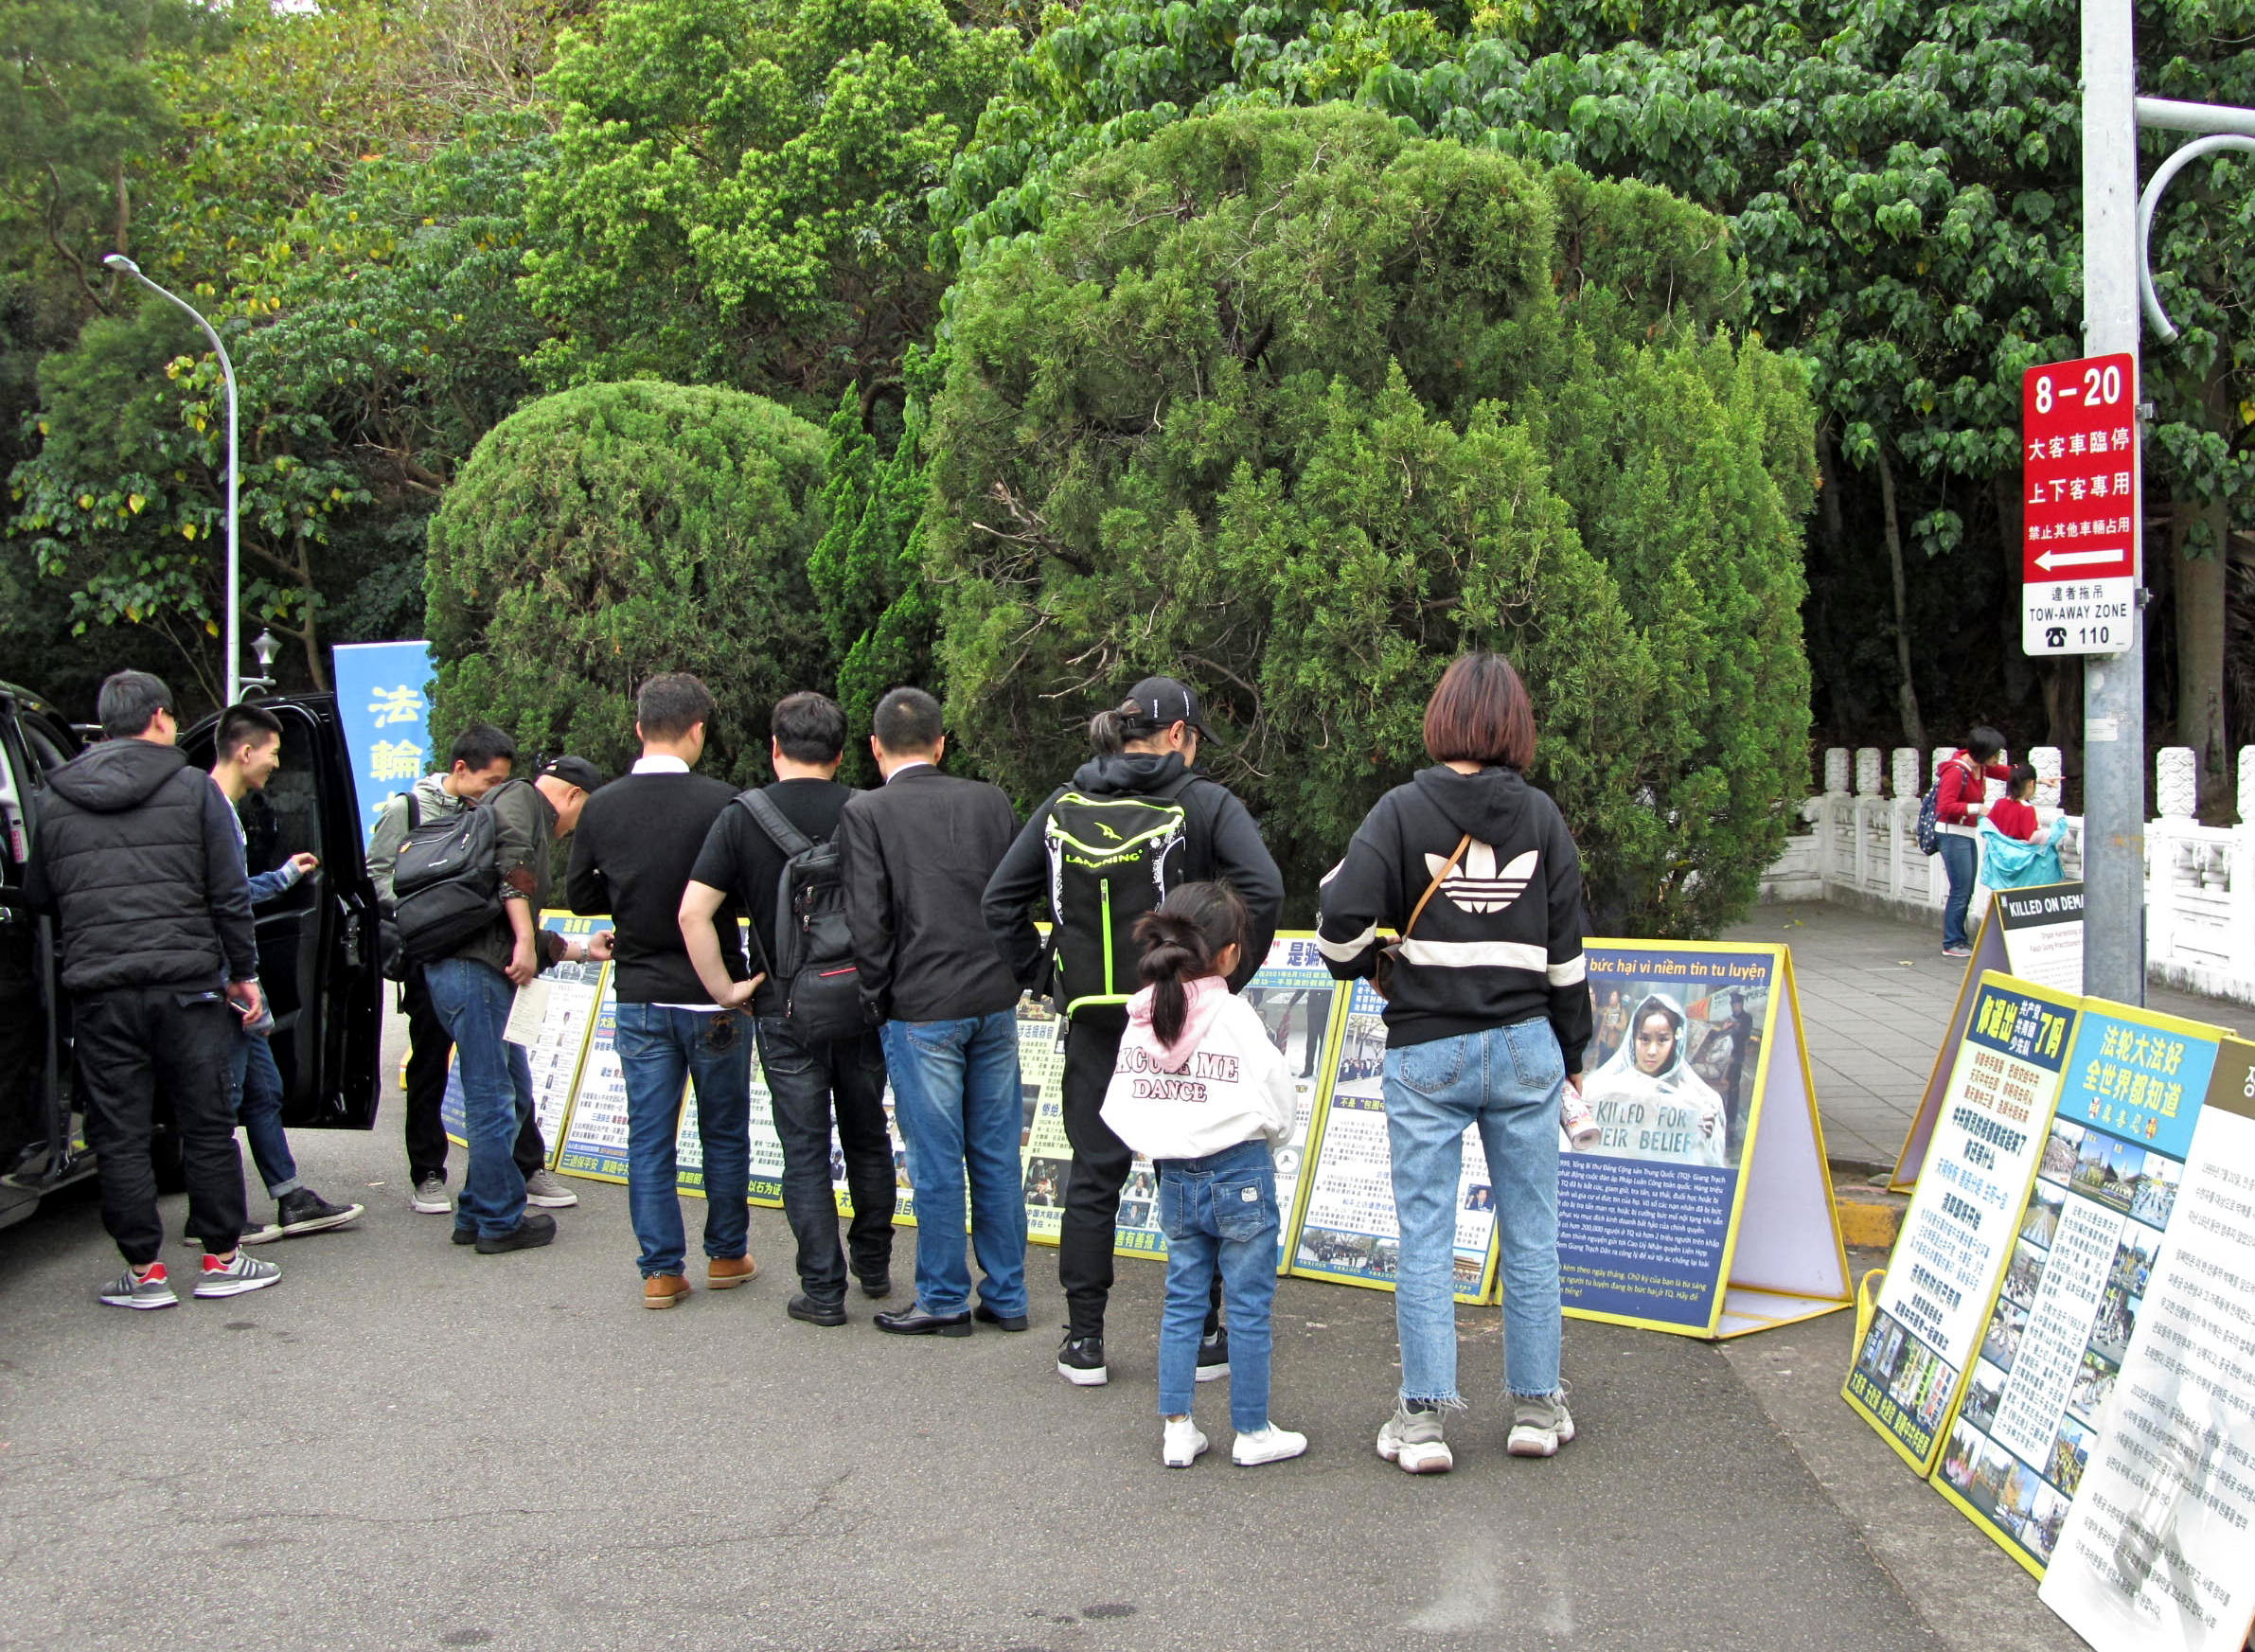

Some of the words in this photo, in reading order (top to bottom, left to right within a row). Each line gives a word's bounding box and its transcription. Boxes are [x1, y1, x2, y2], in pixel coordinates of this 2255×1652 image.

[2028, 427, 2129, 461] 大客車臨停
[2028, 471, 2129, 505] 上下客專用
[2029, 516, 2129, 541] 禁止其他車輛占用
[2051, 585, 2104, 601] 違者拖吊
[2029, 606, 2090, 621] TOW-AWAY
[2095, 603, 2127, 618] ZONE
[2079, 627, 2109, 645] 110
[2009, 899, 2042, 916] KILLED
[2045, 897, 2060, 913] ON
[1589, 959, 1613, 972] bức
[1617, 959, 1637, 976] hại
[1640, 960, 1651, 973] vì
[1654, 958, 1686, 975] niềm
[1690, 962, 1708, 976] tin
[1712, 963, 1726, 976] tu
[1729, 962, 1766, 981] luyện
[2018, 1000, 2042, 1021] 共产党
[2014, 1018, 2037, 1039] 共青团
[2033, 1012, 2067, 1058] 了吗
[2008, 1035, 2032, 1057] 少先队
[2100, 1025, 2185, 1075] 法轮大法好
[1197, 1052, 1239, 1083] ME
[1132, 1078, 1207, 1102] DANCE
[2082, 1059, 2182, 1118] 全世界都知道
[1658, 1106, 1687, 1128] FOR
[748, 1181, 782, 1196] 以石为证
